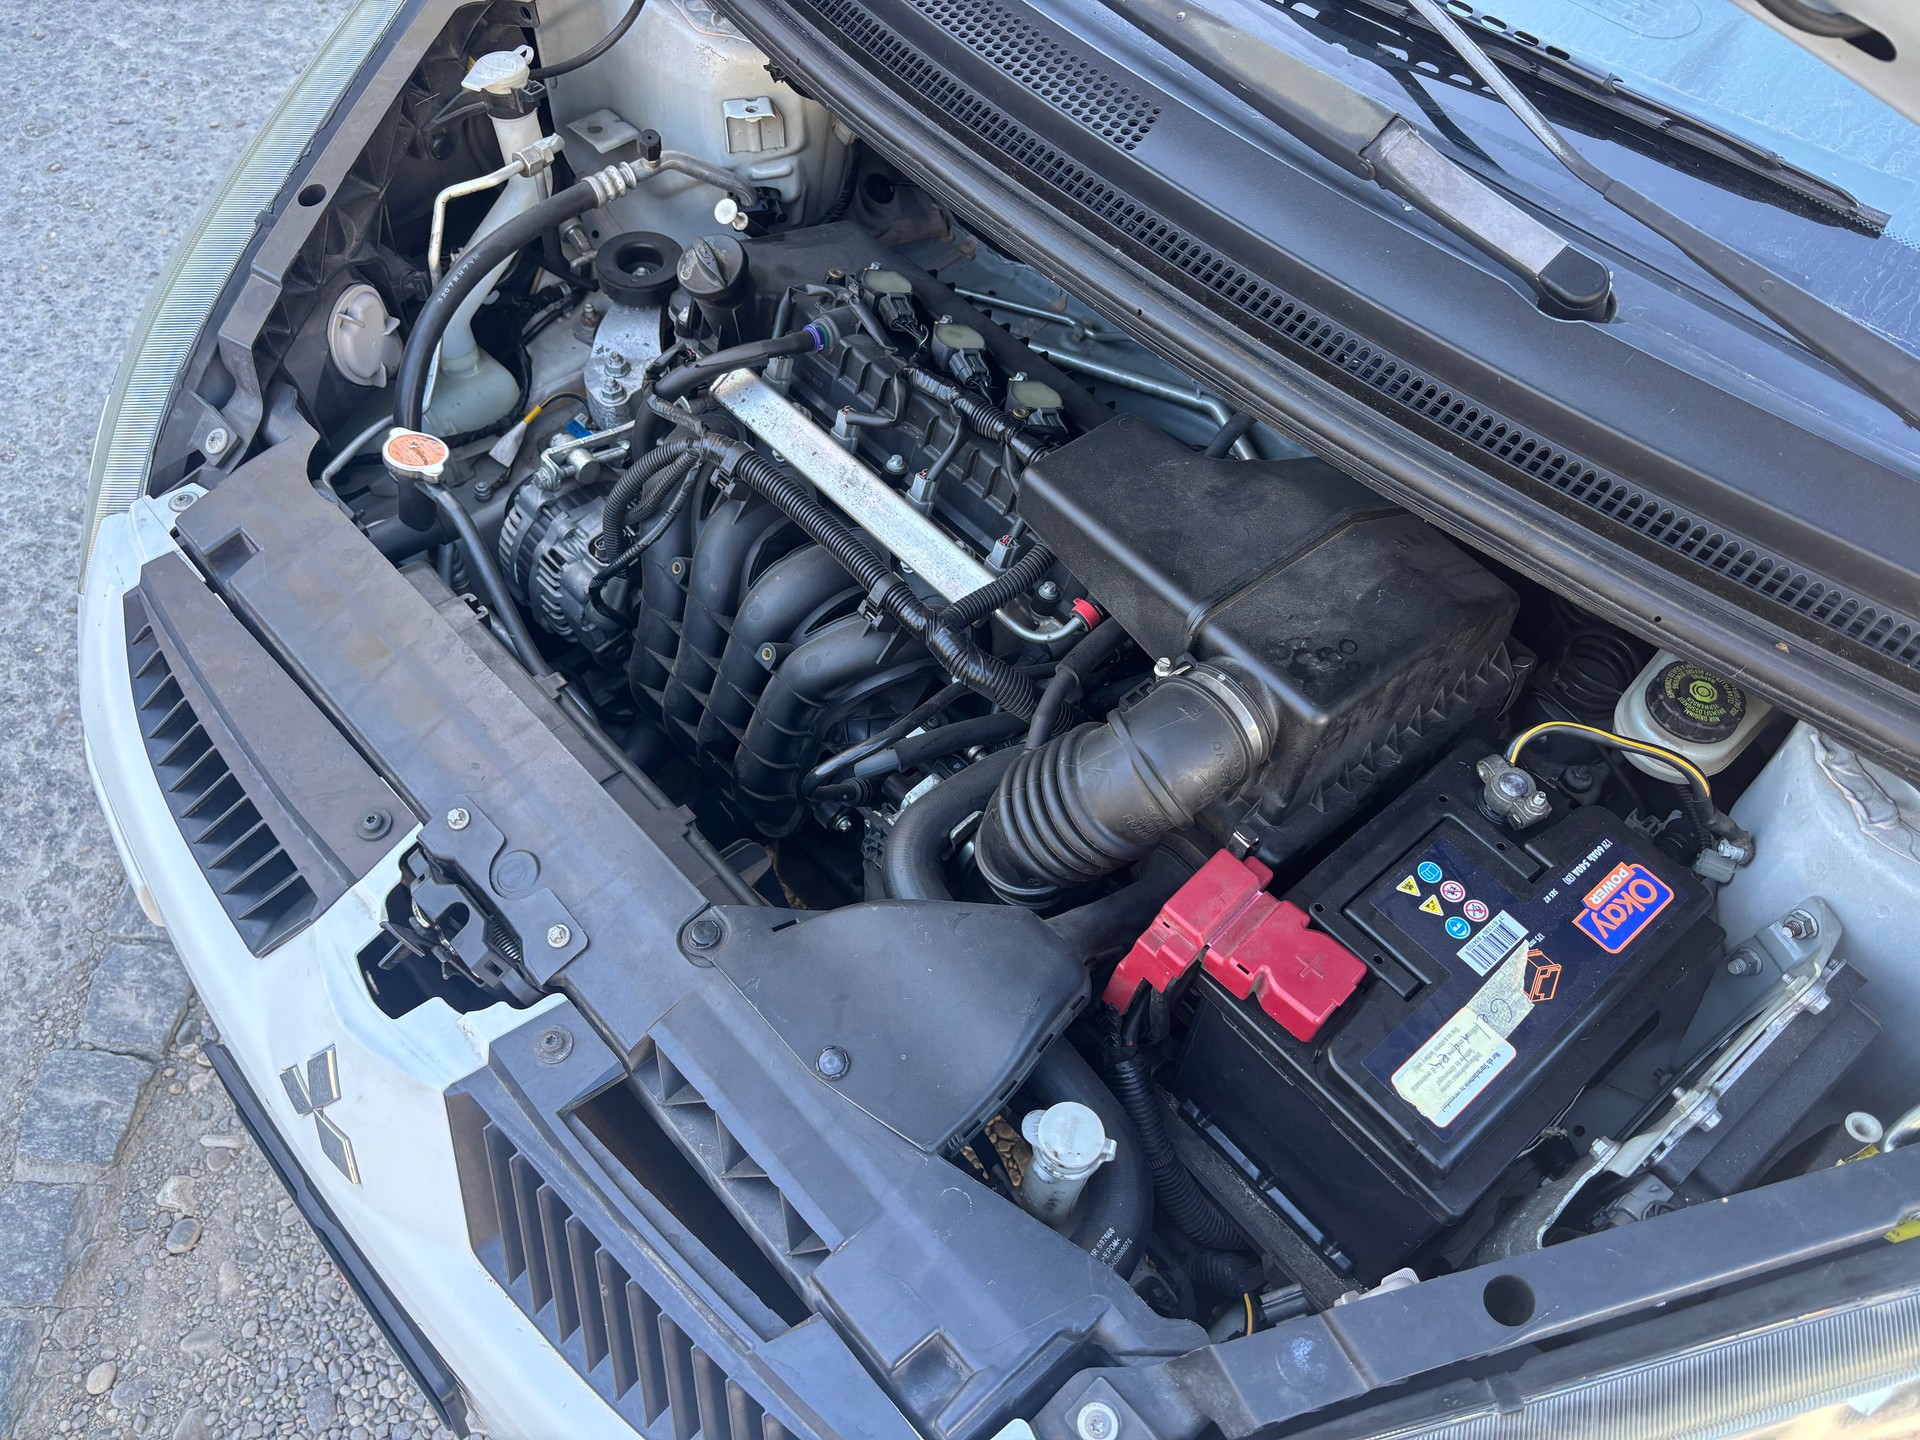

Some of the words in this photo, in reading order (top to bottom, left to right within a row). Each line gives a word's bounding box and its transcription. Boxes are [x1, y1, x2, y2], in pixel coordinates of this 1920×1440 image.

[1682, 707, 1708, 721] ORIGINAL
[1585, 843, 1606, 864] 60Ah
[1599, 837, 1613, 849] 12V
[1570, 857, 1591, 878] 540A
[1587, 866, 1629, 906] POWER
[1590, 878, 1657, 940] Okay
[1490, 1050, 1501, 1061] Nur
[1463, 1062, 1490, 1089] Starterbatterie
